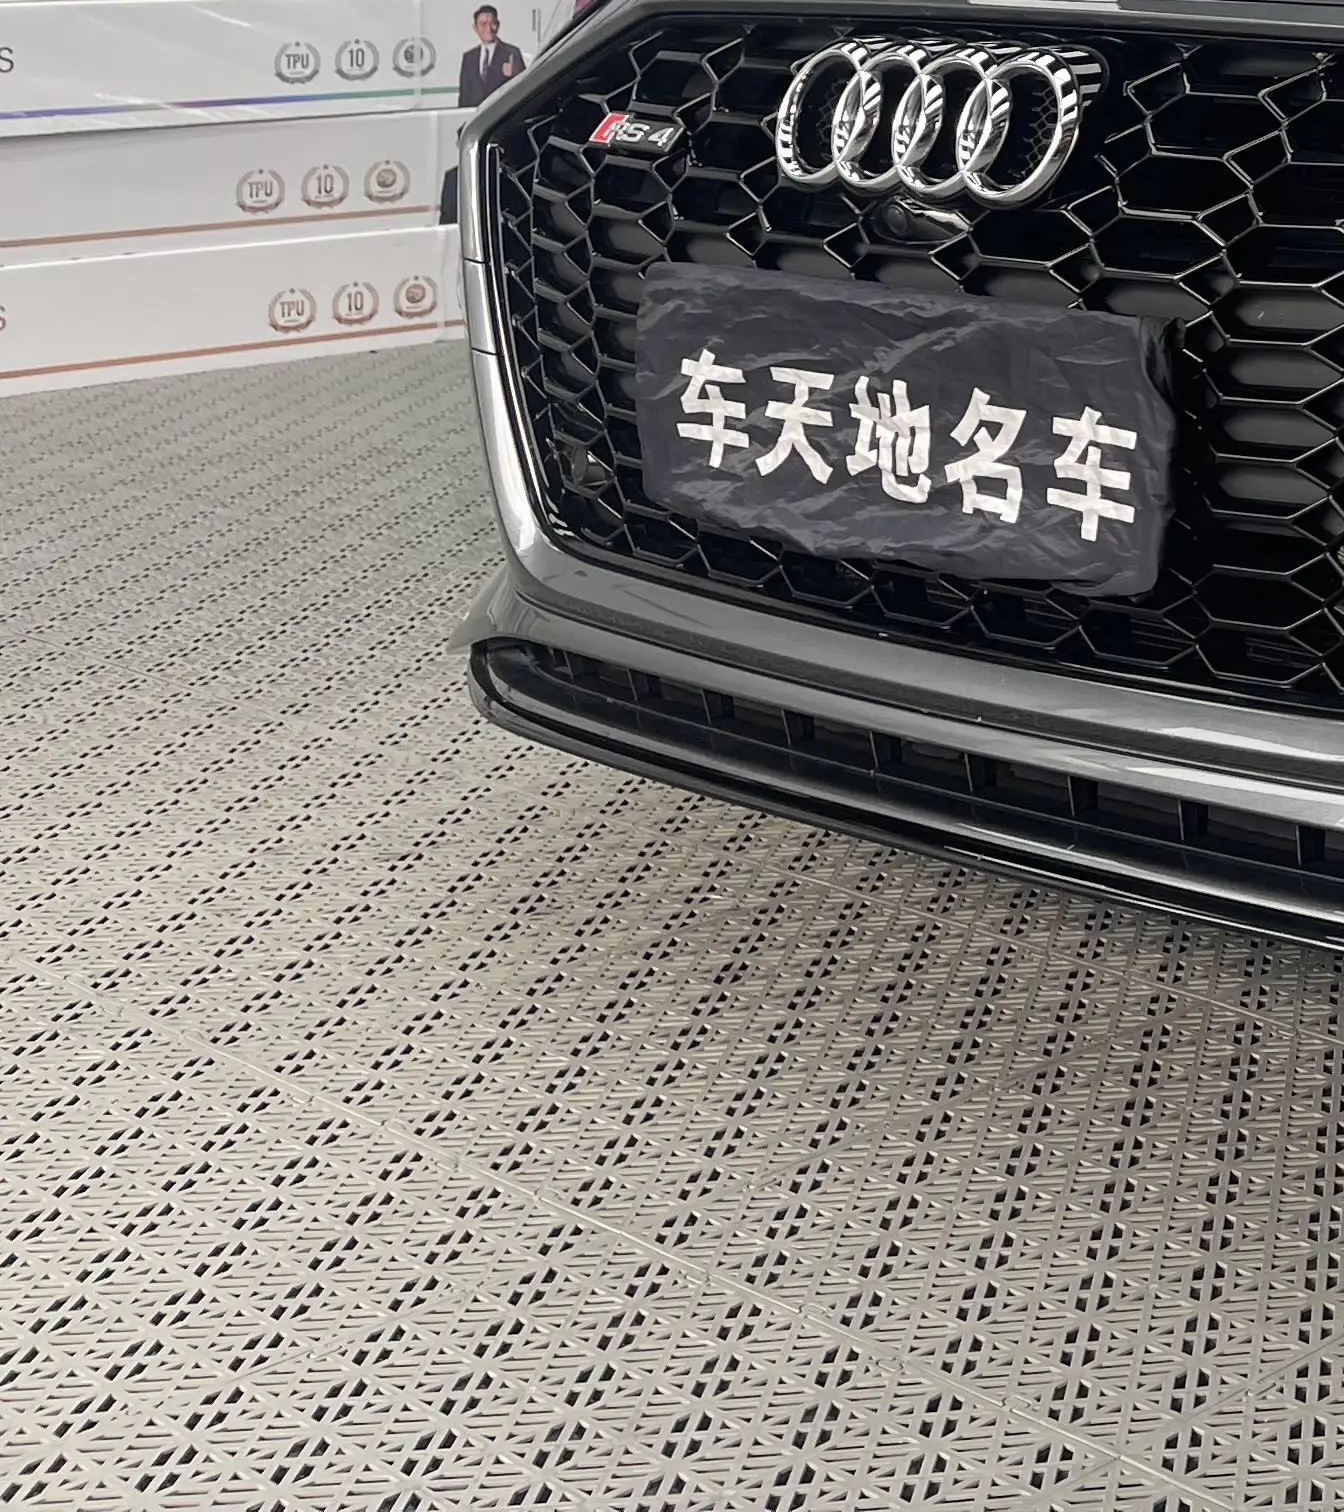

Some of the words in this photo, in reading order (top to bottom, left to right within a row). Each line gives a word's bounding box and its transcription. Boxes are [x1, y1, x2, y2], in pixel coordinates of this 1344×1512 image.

[285, 53, 309, 70] TPU
[348, 48, 365, 68] 10
[248, 181, 273, 198] TPU
[316, 174, 334, 194] 10
[279, 300, 304, 318] TPU
[347, 291, 364, 312] 10
[676, 349, 1138, 543] 车天地名车
